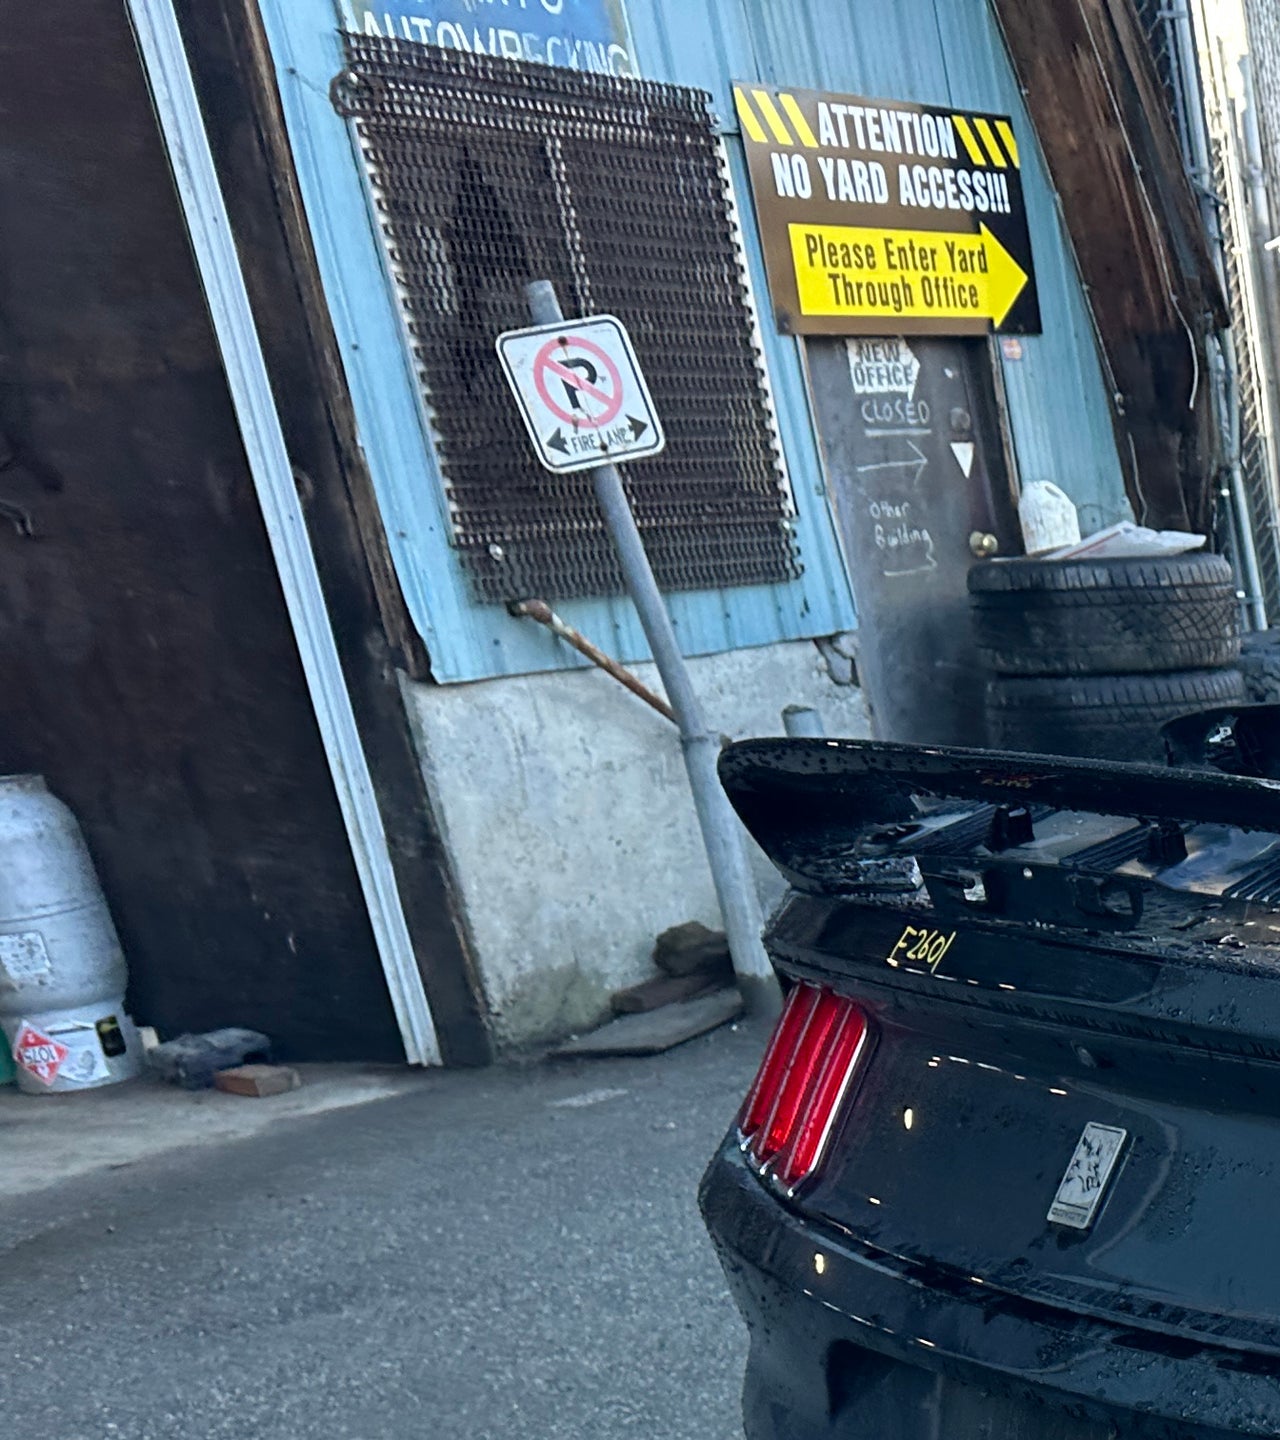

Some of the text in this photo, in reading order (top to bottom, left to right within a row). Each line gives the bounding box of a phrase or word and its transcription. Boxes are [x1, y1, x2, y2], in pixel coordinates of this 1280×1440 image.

[817, 101, 957, 159] ATTENTION
[771, 152, 1011, 214] NO YARD ACCESS!!!
[805, 233, 988, 273] Please Enter Yard
[828, 272, 979, 312] Through Office
[858, 343, 901, 363] NEW
[853, 363, 915, 387] OFFICE
[861, 400, 930, 424] CLOSED
[571, 433, 600, 454] FIRE
[889, 926, 957, 974] F2601
